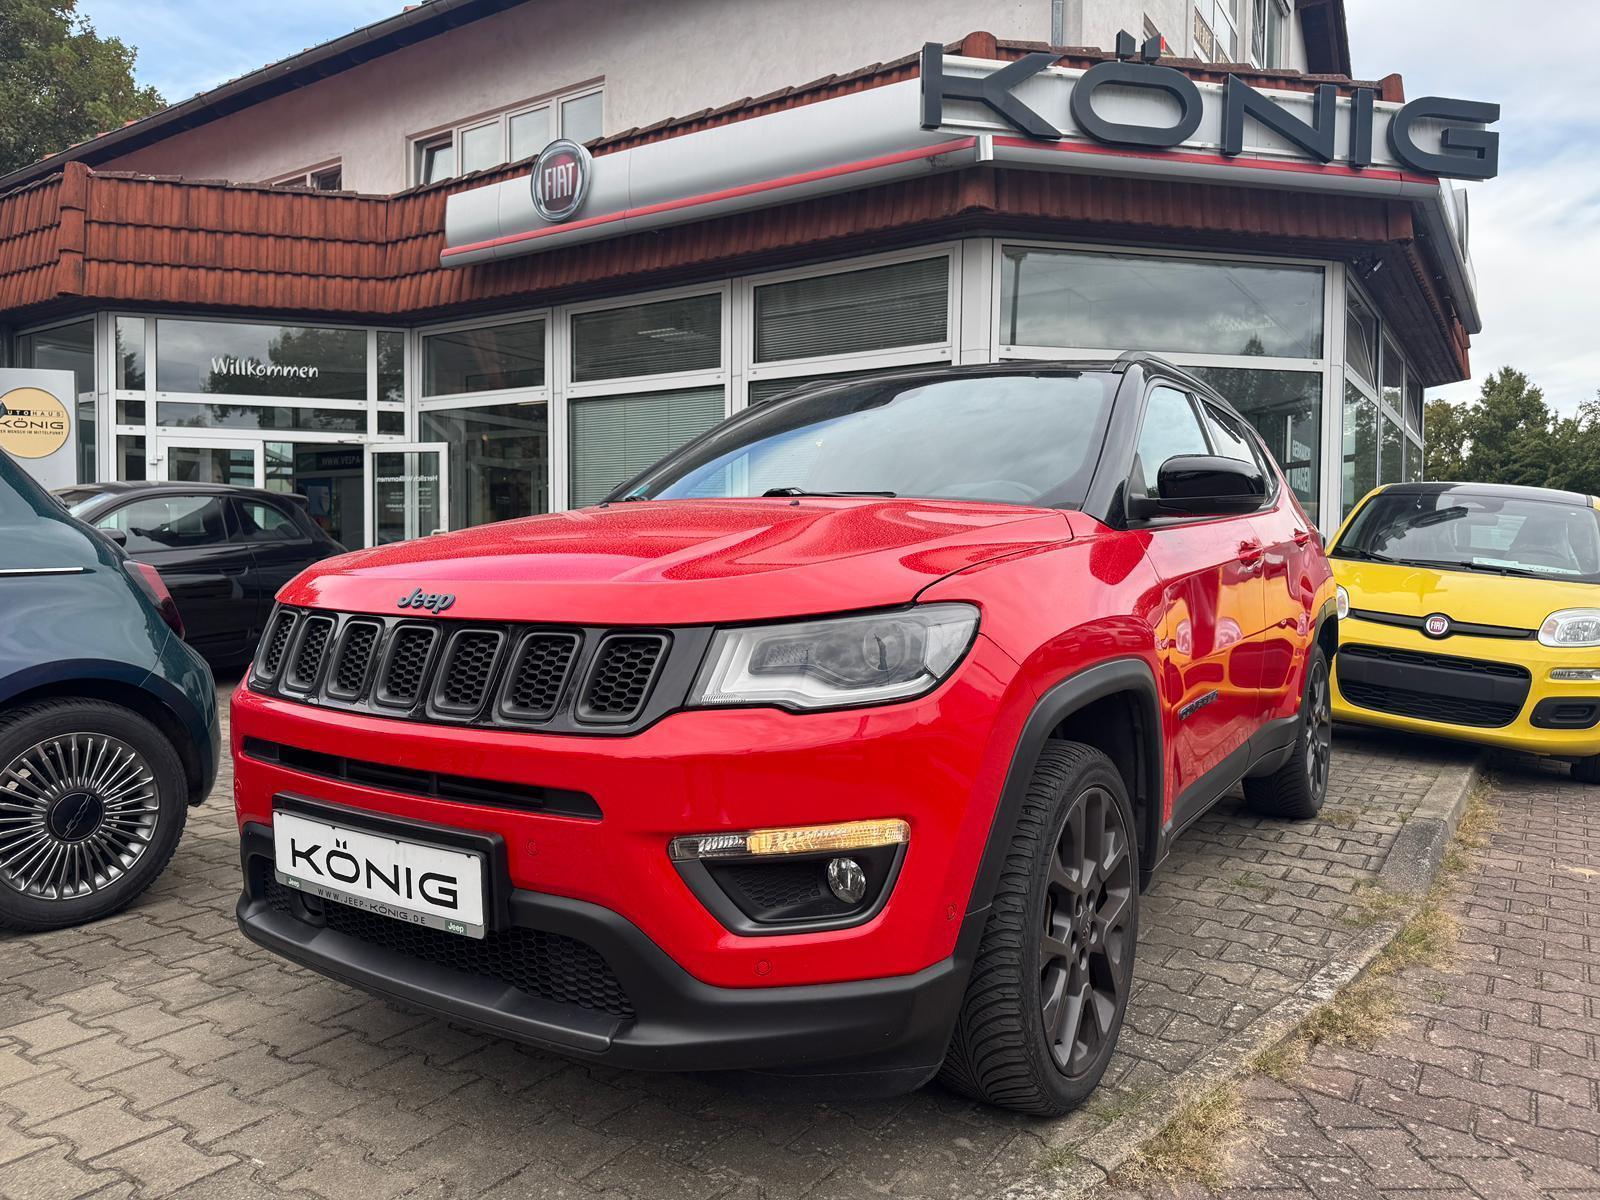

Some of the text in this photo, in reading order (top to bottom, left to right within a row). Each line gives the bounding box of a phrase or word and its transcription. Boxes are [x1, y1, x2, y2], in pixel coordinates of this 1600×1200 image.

[920, 29, 1500, 180] KÖNIG
[545, 162, 575, 201] FIAT
[211, 357, 319, 378] Willkommen
[397, 587, 456, 614] Jeep
[1430, 620, 1444, 631] FIAT
[288, 877, 300, 888] Jeep
[290, 837, 458, 910] KÖNIG
[448, 922, 464, 933] Jeep
